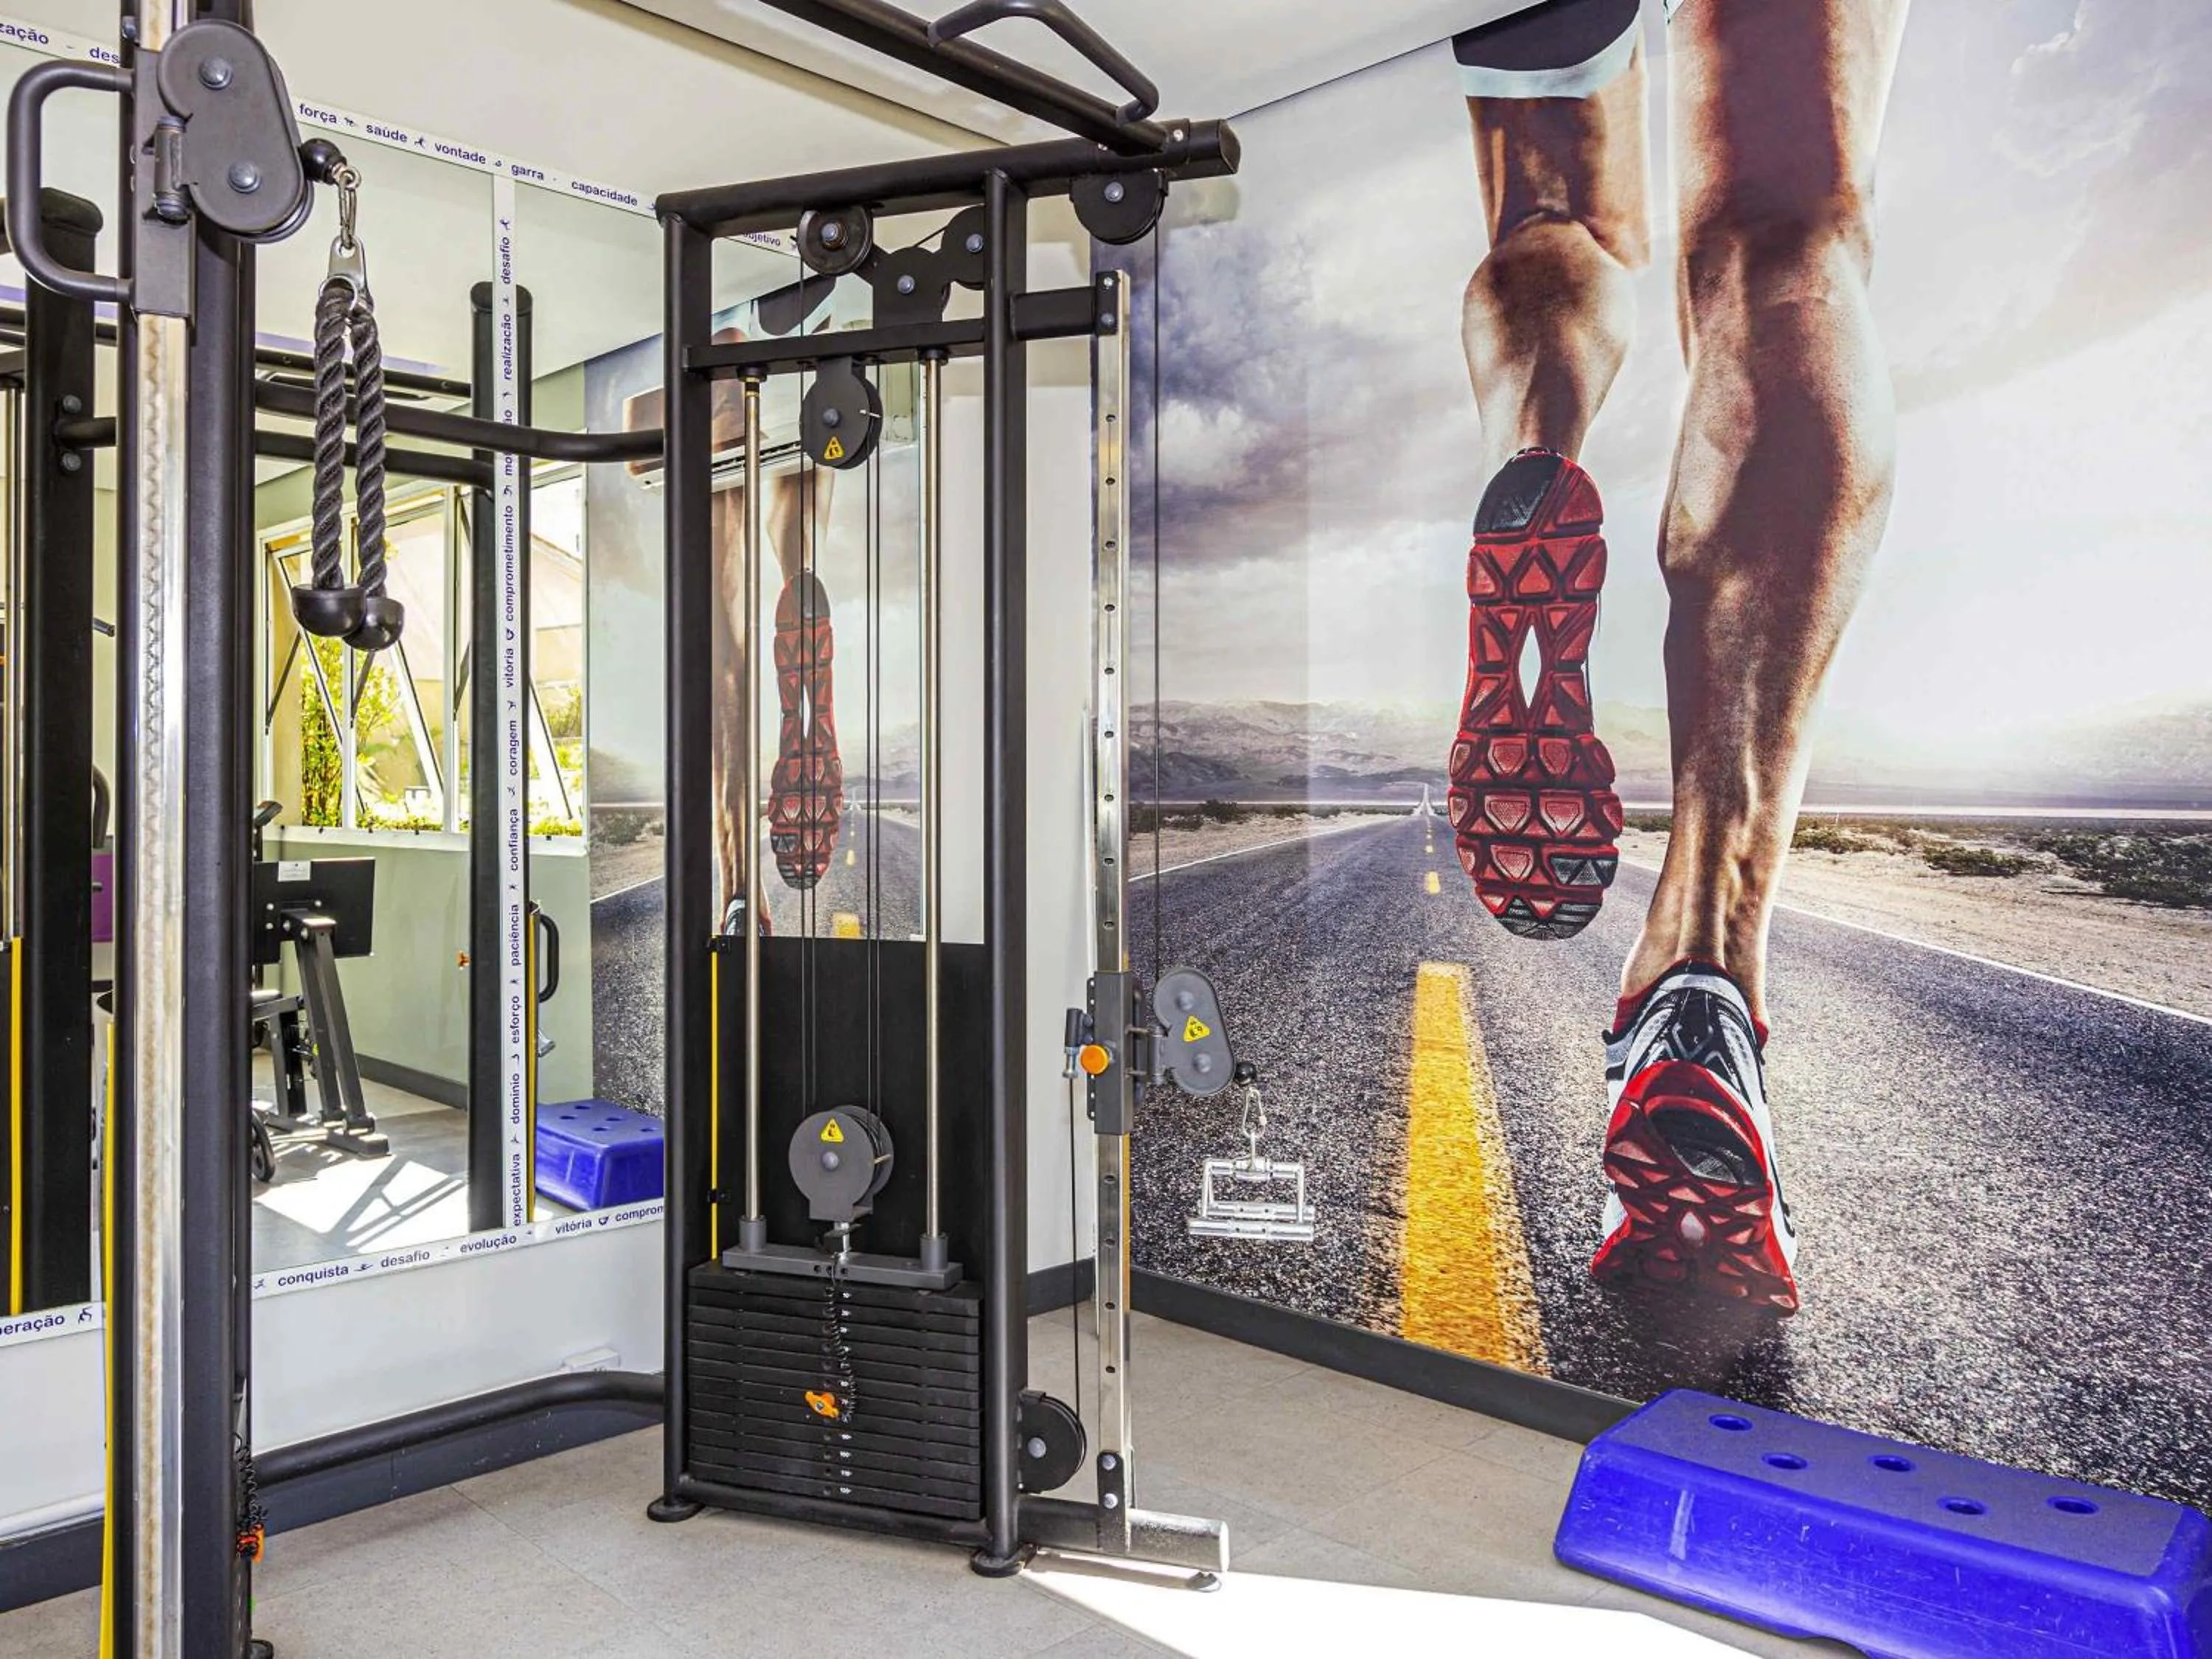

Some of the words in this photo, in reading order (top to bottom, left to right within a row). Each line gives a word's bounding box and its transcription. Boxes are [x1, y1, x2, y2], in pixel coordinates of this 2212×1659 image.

[298, 103, 337, 124] força
[366, 124, 408, 143] saúde
[434, 142, 487, 164] vontade
[511, 164, 545, 181] garra
[571, 181, 639, 206] capacidade
[500, 237, 511, 285] desafio
[504, 505, 515, 622] comprometimento
[504, 648, 515, 688] vitória
[509, 720, 520, 776] coragem
[509, 808, 520, 872] confiança
[509, 904, 522, 967] paciência
[509, 995, 522, 1044] esforço
[511, 1153, 523, 1227] expectativa
[0, 1315, 65, 1335] eração
[276, 1264, 349, 1287] conquista
[380, 1249, 431, 1269] desafio
[459, 1232, 518, 1255] evolução
[555, 1217, 592, 1234] vitória
